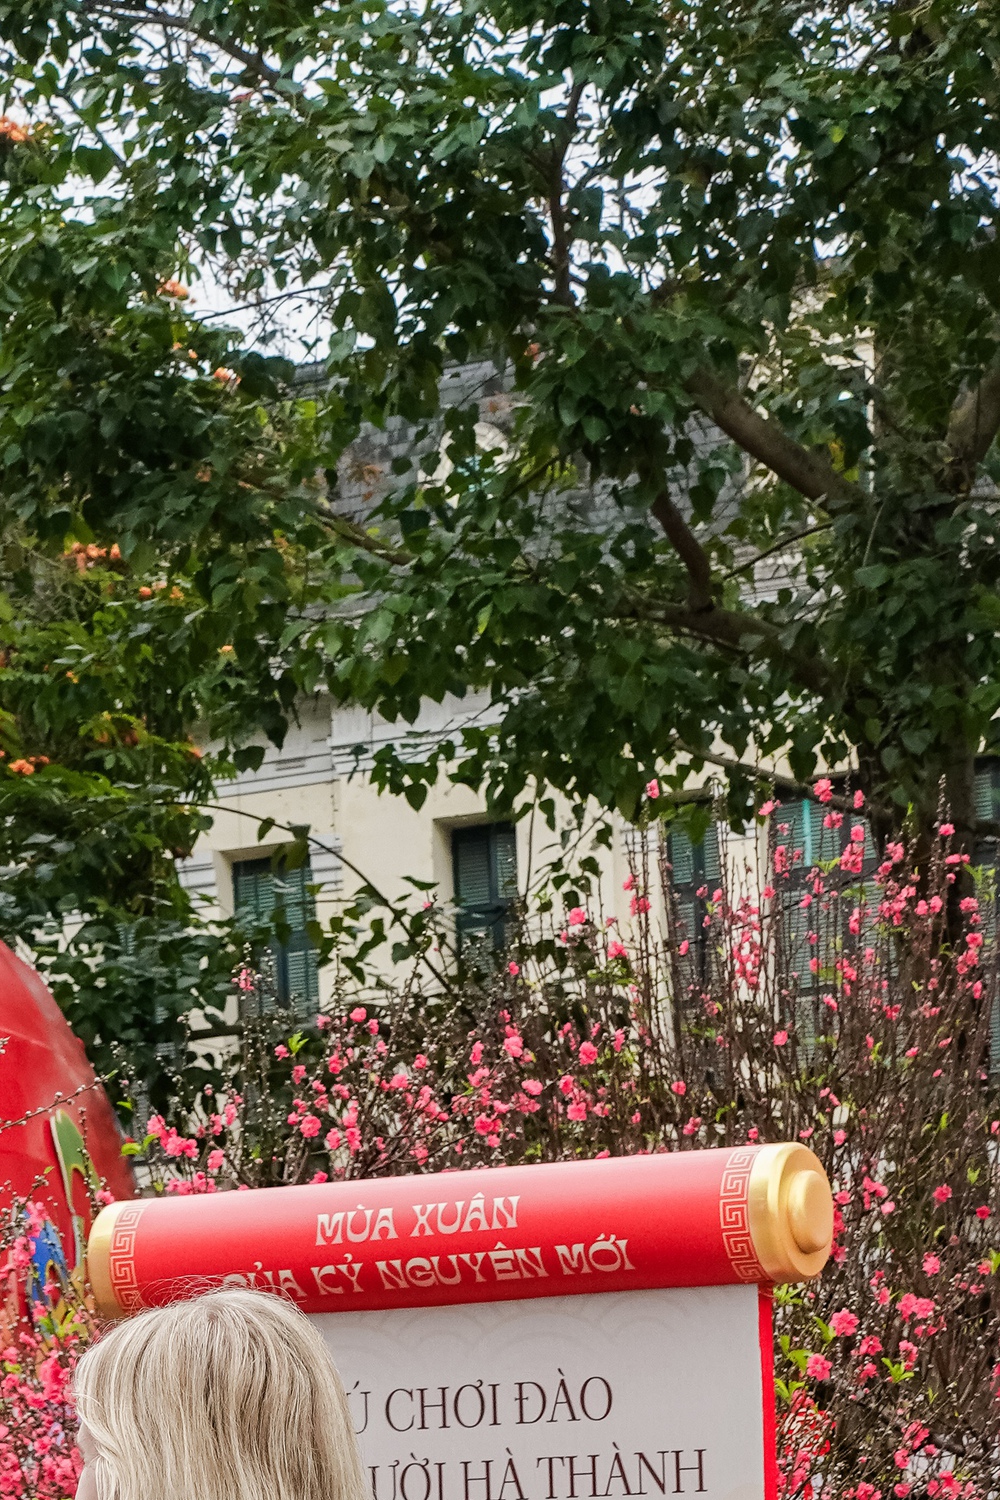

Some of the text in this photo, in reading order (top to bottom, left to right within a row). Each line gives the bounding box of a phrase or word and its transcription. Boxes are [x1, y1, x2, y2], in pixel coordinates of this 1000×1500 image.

[315, 1191, 520, 1246] MÙA XUÂN
[311, 1253, 364, 1296] KỶ
[375, 1241, 550, 1290] NGUYÊN
[555, 1233, 636, 1275] MỚI
[385, 1379, 502, 1432] CHƠI
[514, 1368, 613, 1425] ĐÀO
[536, 1441, 708, 1500] THÀNH
